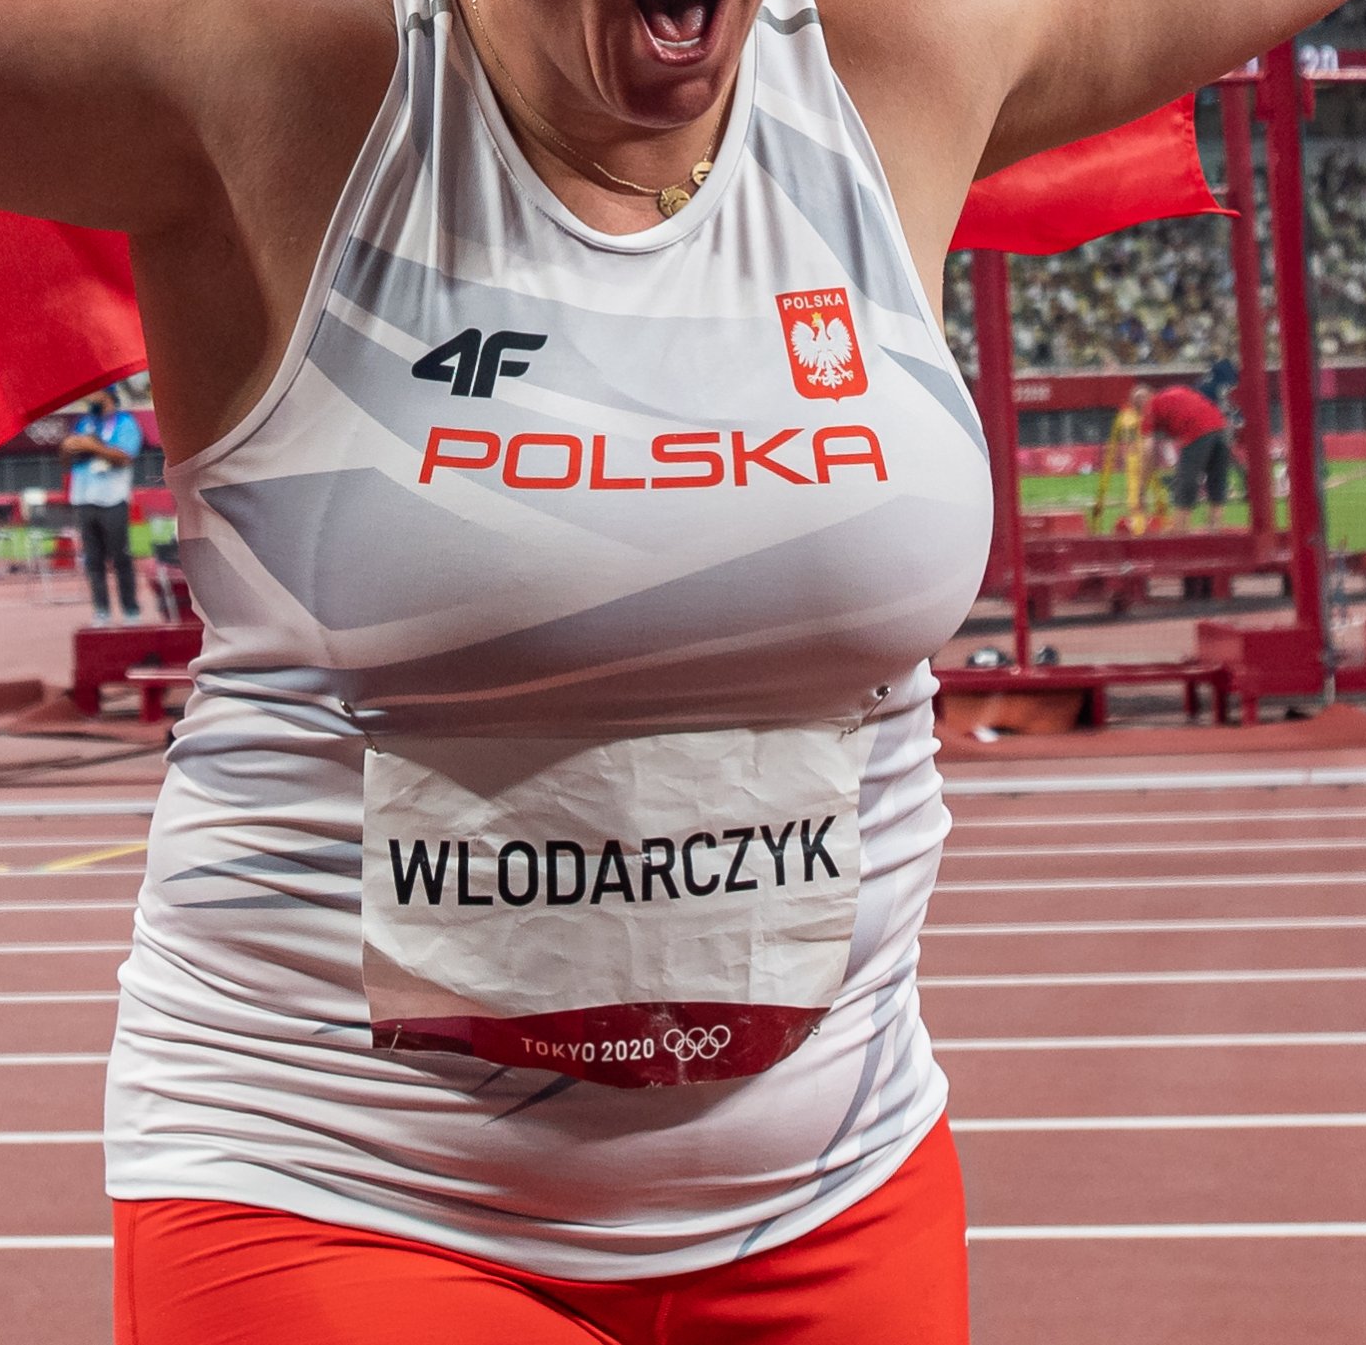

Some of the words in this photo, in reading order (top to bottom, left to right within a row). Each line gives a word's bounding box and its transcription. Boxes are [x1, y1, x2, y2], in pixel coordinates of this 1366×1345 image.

[782, 292, 845, 311] POLSKA
[411, 328, 549, 398] 4F
[418, 425, 889, 490] POLSKA
[388, 815, 841, 907] WLODARCZYK
[521, 1037, 595, 1062] TOKYO
[601, 1038, 655, 1062] 2020
